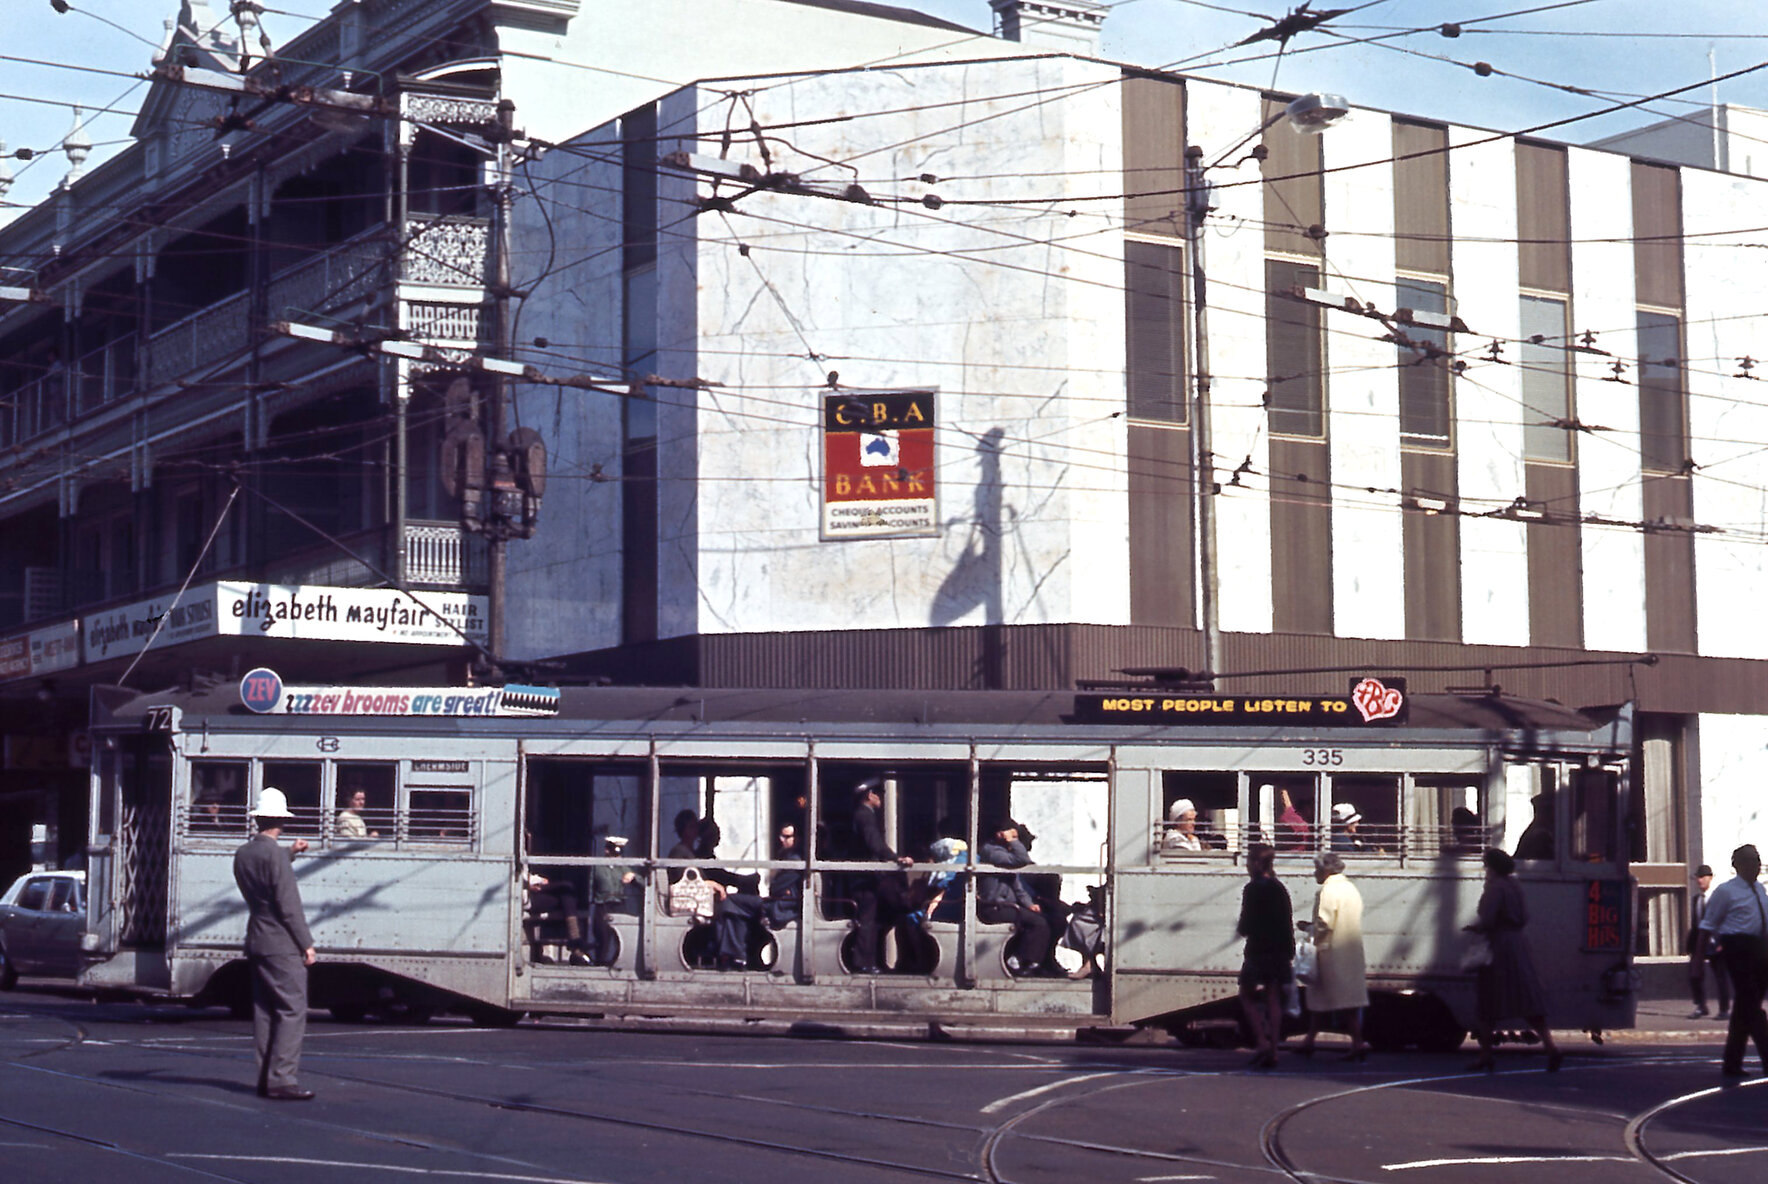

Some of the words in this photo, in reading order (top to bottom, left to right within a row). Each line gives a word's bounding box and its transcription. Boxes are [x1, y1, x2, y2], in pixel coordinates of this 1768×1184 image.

[835, 472, 925, 496] BANK
[875, 505, 929, 516] ACCOUNTS
[232, 590, 337, 631] elizabeth
[346, 598, 430, 631] mayfair
[442, 603, 477, 616] HAIR
[435, 618, 484, 630] STYLIST
[247, 678, 278, 701] ZEV
[341, 690, 409, 712] brooms
[411, 695, 441, 712] are
[443, 691, 502, 713] great!
[1102, 699, 1155, 711] MOST
[1162, 699, 1235, 712] PEOPLE
[1244, 700, 1312, 712] LISTEN
[1319, 701, 1347, 712] TO
[147, 709, 171, 730] 72
[1302, 749, 1343, 766] 335
